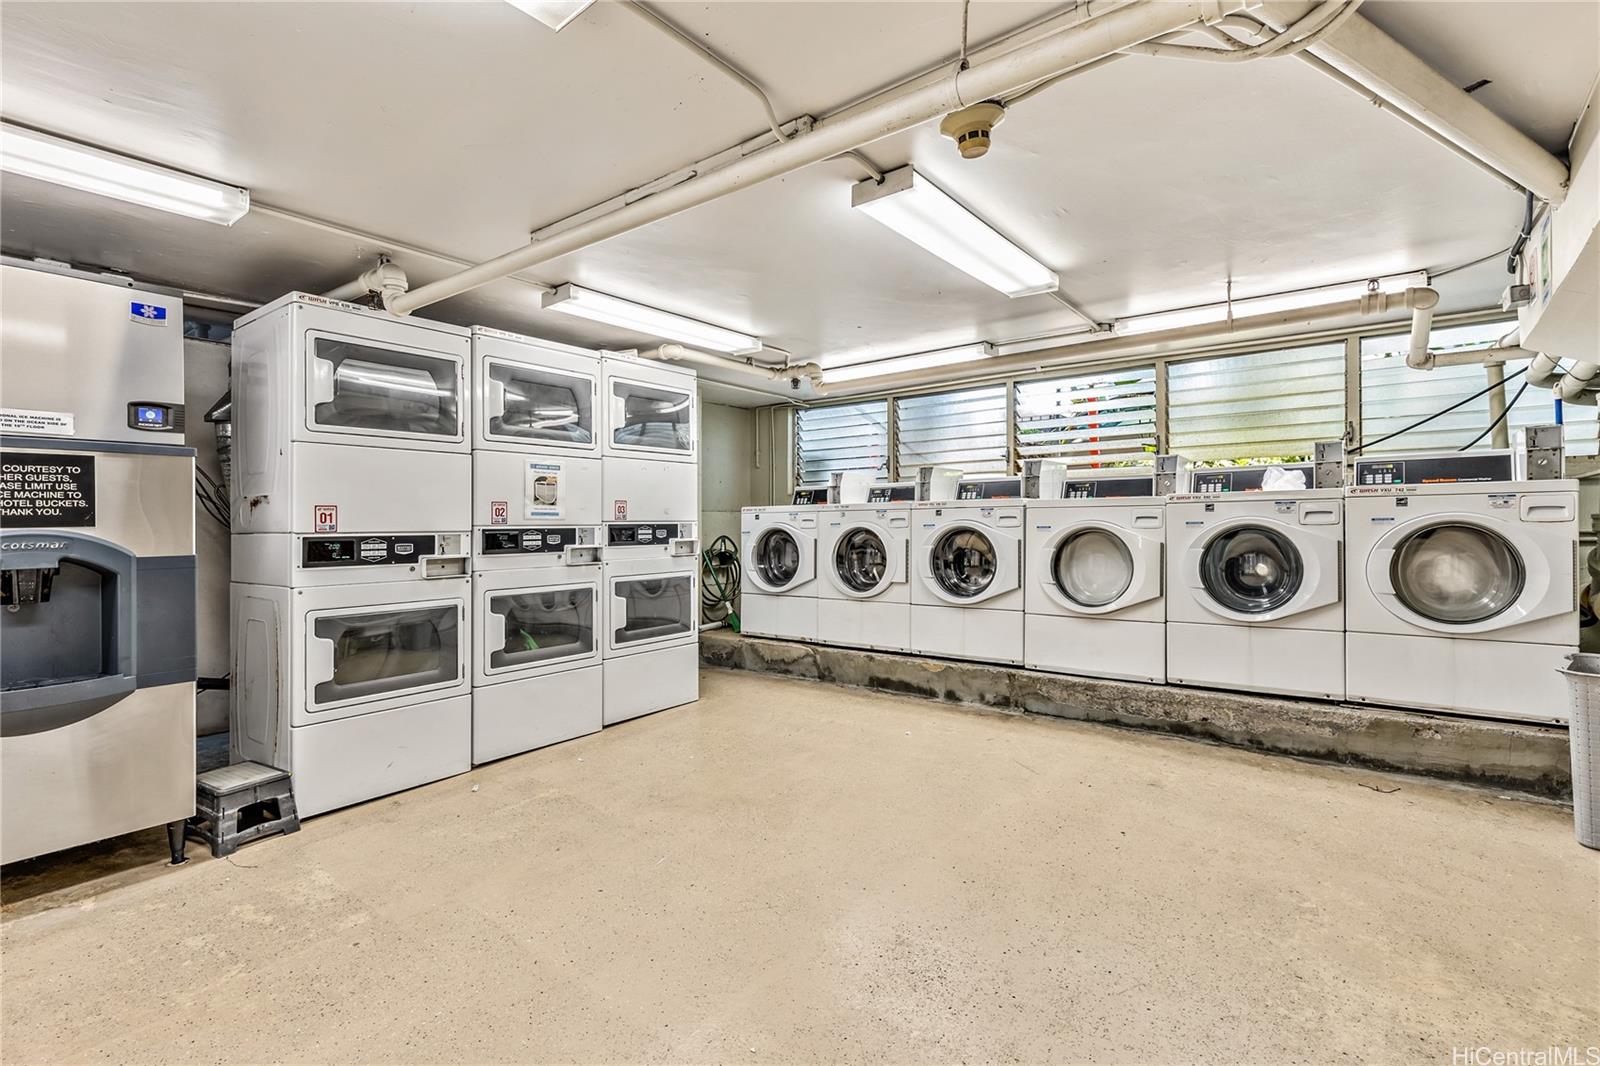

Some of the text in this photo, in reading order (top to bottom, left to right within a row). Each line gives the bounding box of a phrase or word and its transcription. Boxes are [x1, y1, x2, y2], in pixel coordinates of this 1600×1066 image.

[2, 464, 81, 474] COURTESY TO
[25, 474, 73, 483] GUESTS,
[0, 482, 78, 491] ASE LIMIT USE
[14, 491, 65, 499] MACHINE
[67, 491, 82, 499] TO
[35, 499, 89, 508] BUCKETS.
[36, 508, 62, 516] YOU.
[495, 507, 505, 517] 02
[617, 505, 626, 514] 03
[320, 512, 333, 524] 01
